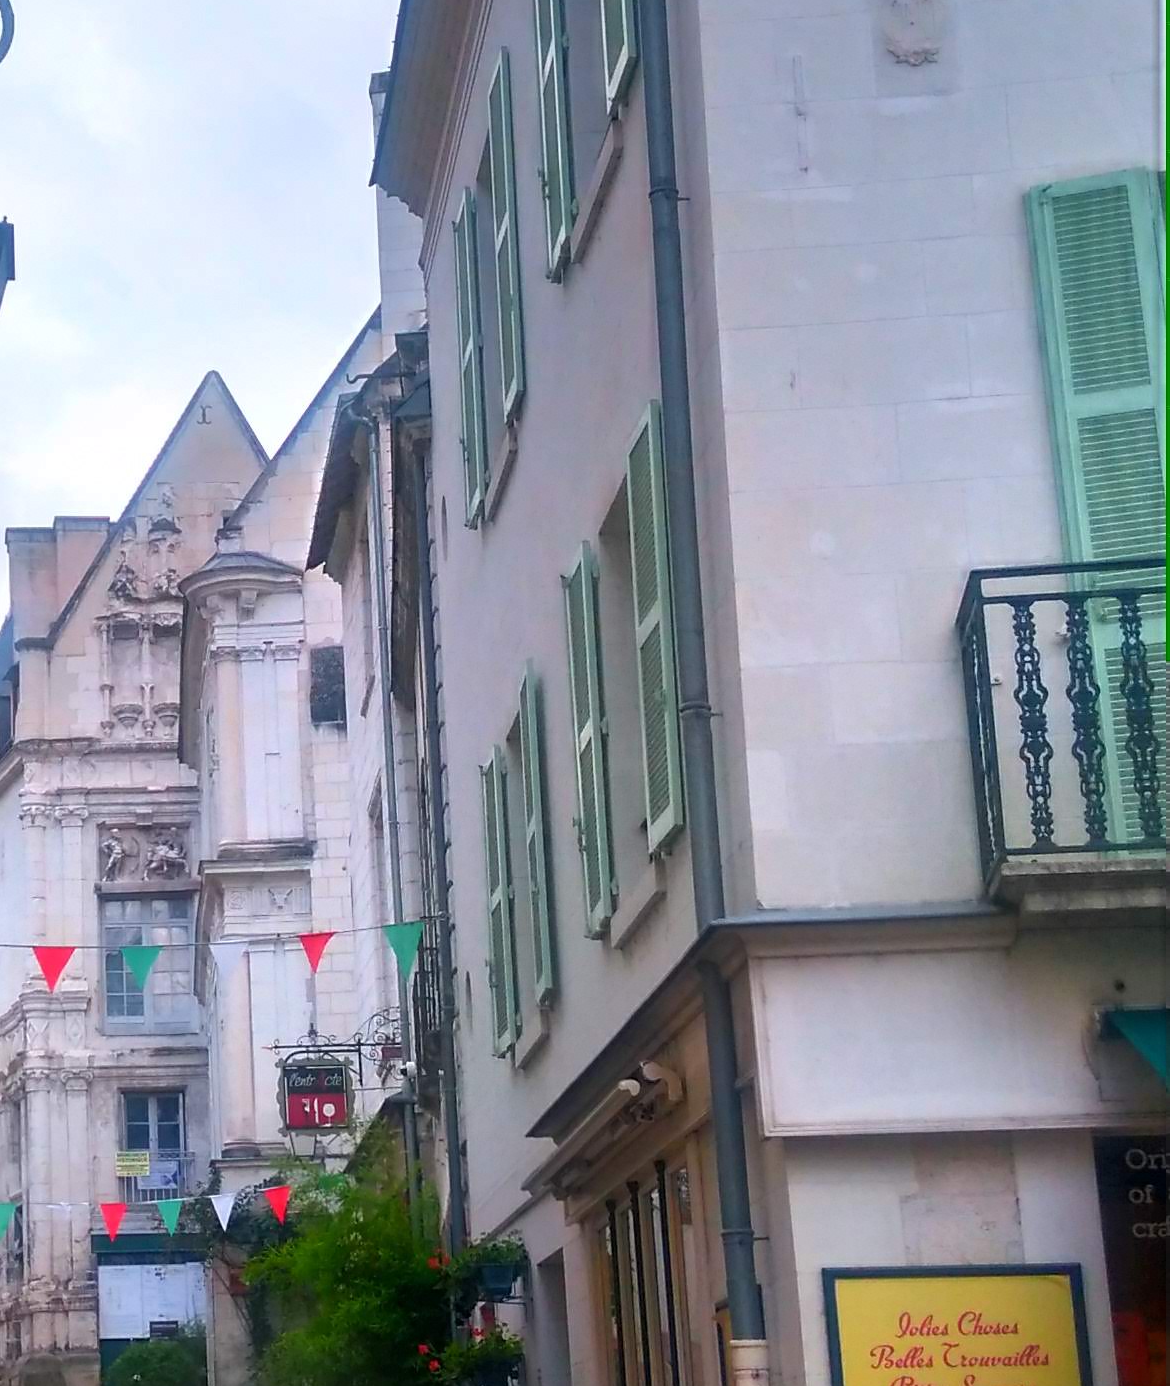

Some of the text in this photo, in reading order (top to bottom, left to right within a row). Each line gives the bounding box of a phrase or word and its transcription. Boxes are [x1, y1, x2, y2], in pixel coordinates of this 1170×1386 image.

[1128, 1184, 1154, 1204] of
[895, 1310, 1019, 1339] Jolies Choses
[870, 1342, 1050, 1369] Belles Trouvailles
